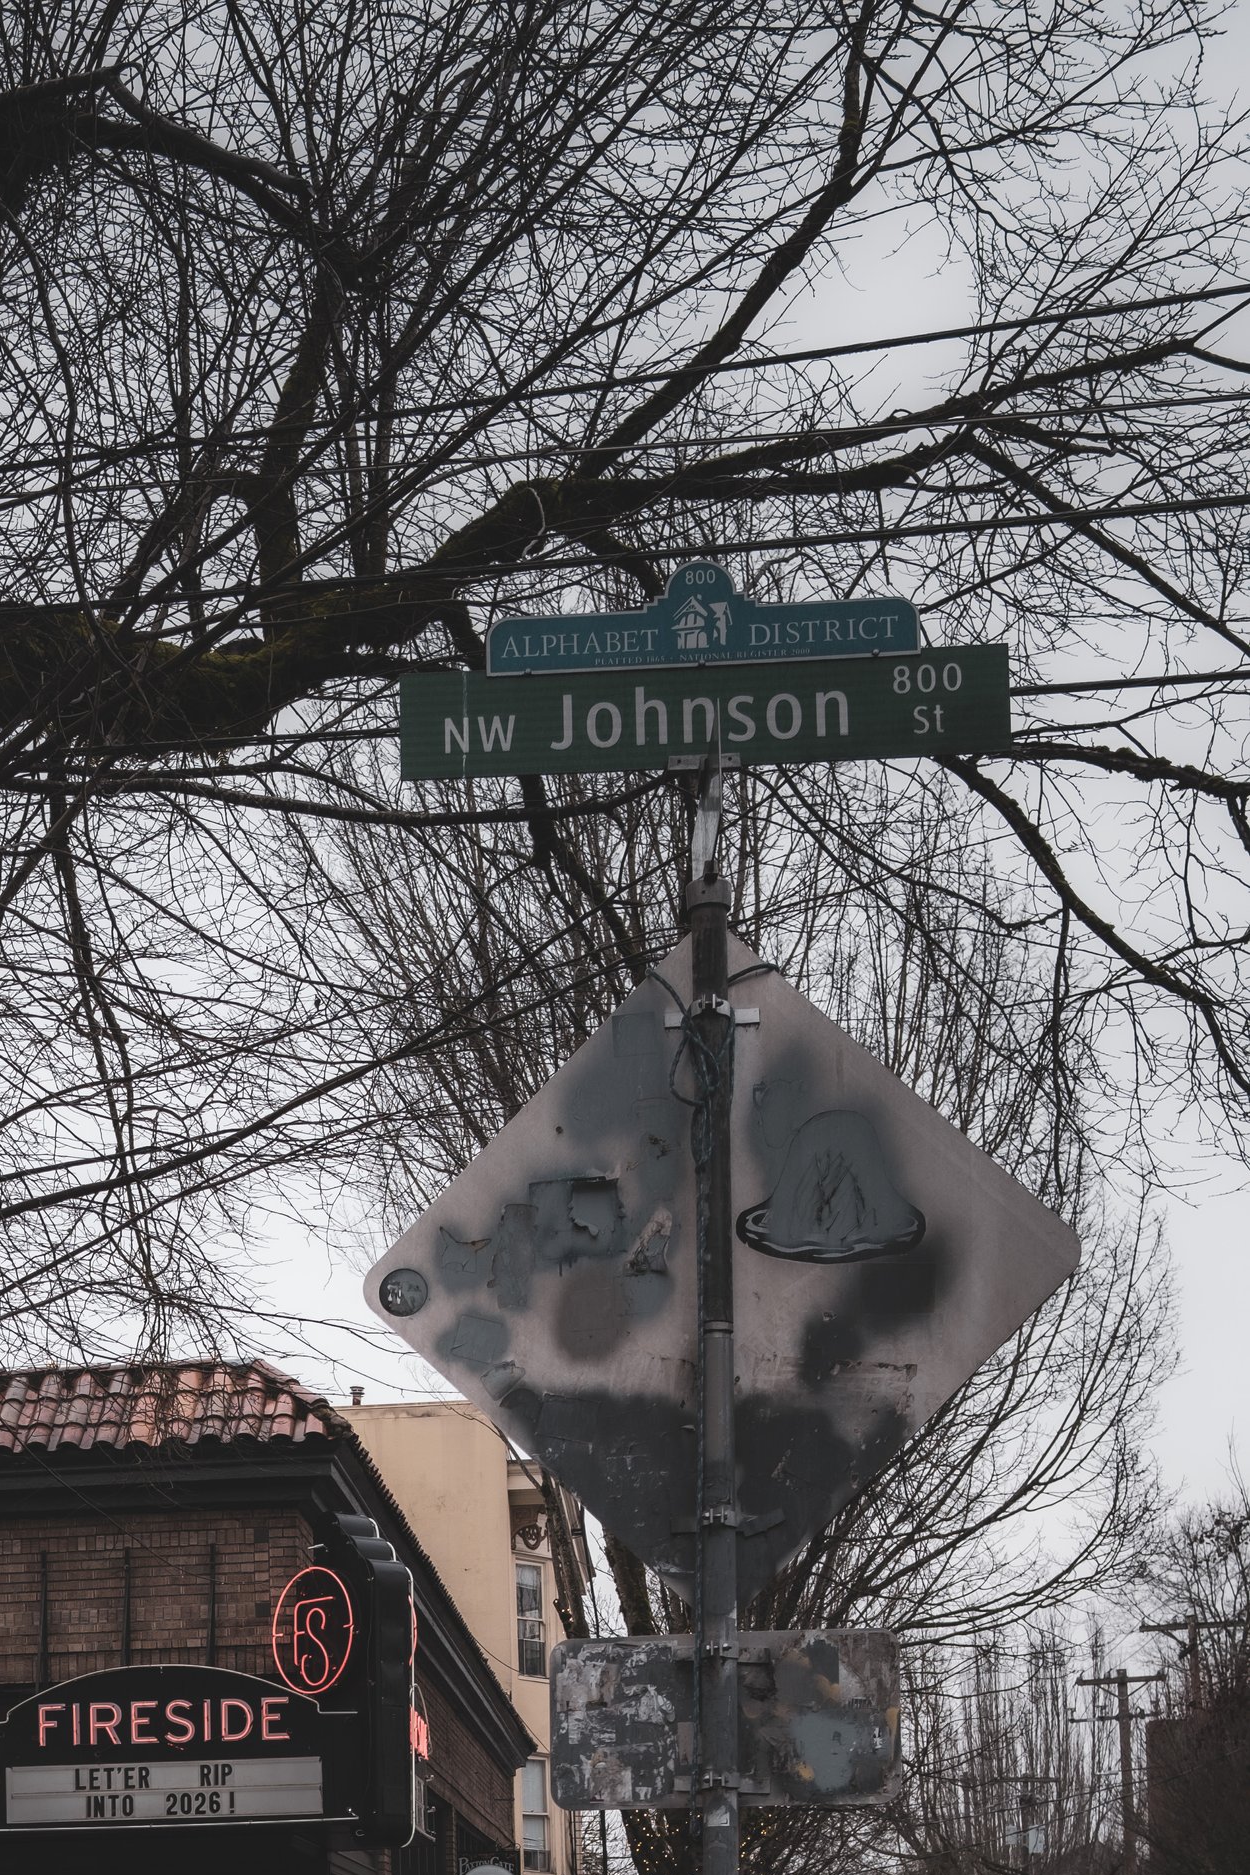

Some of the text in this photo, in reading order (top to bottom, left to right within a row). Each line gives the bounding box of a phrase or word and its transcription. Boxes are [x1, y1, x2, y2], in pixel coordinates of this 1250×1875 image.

[685, 569, 716, 585] 800
[501, 615, 899, 659] ALPHABET DISTRICT
[594, 656, 643, 666] PLATTED
[679, 651, 733, 662] NATIONAL
[735, 649, 788, 659] REGISTER
[892, 662, 962, 695] 800
[443, 686, 944, 754] NW Johnson St
[38, 1695, 291, 1748] FIRESIDE
[199, 1763, 233, 1787] RIP
[85, 1794, 134, 1818] INTO
